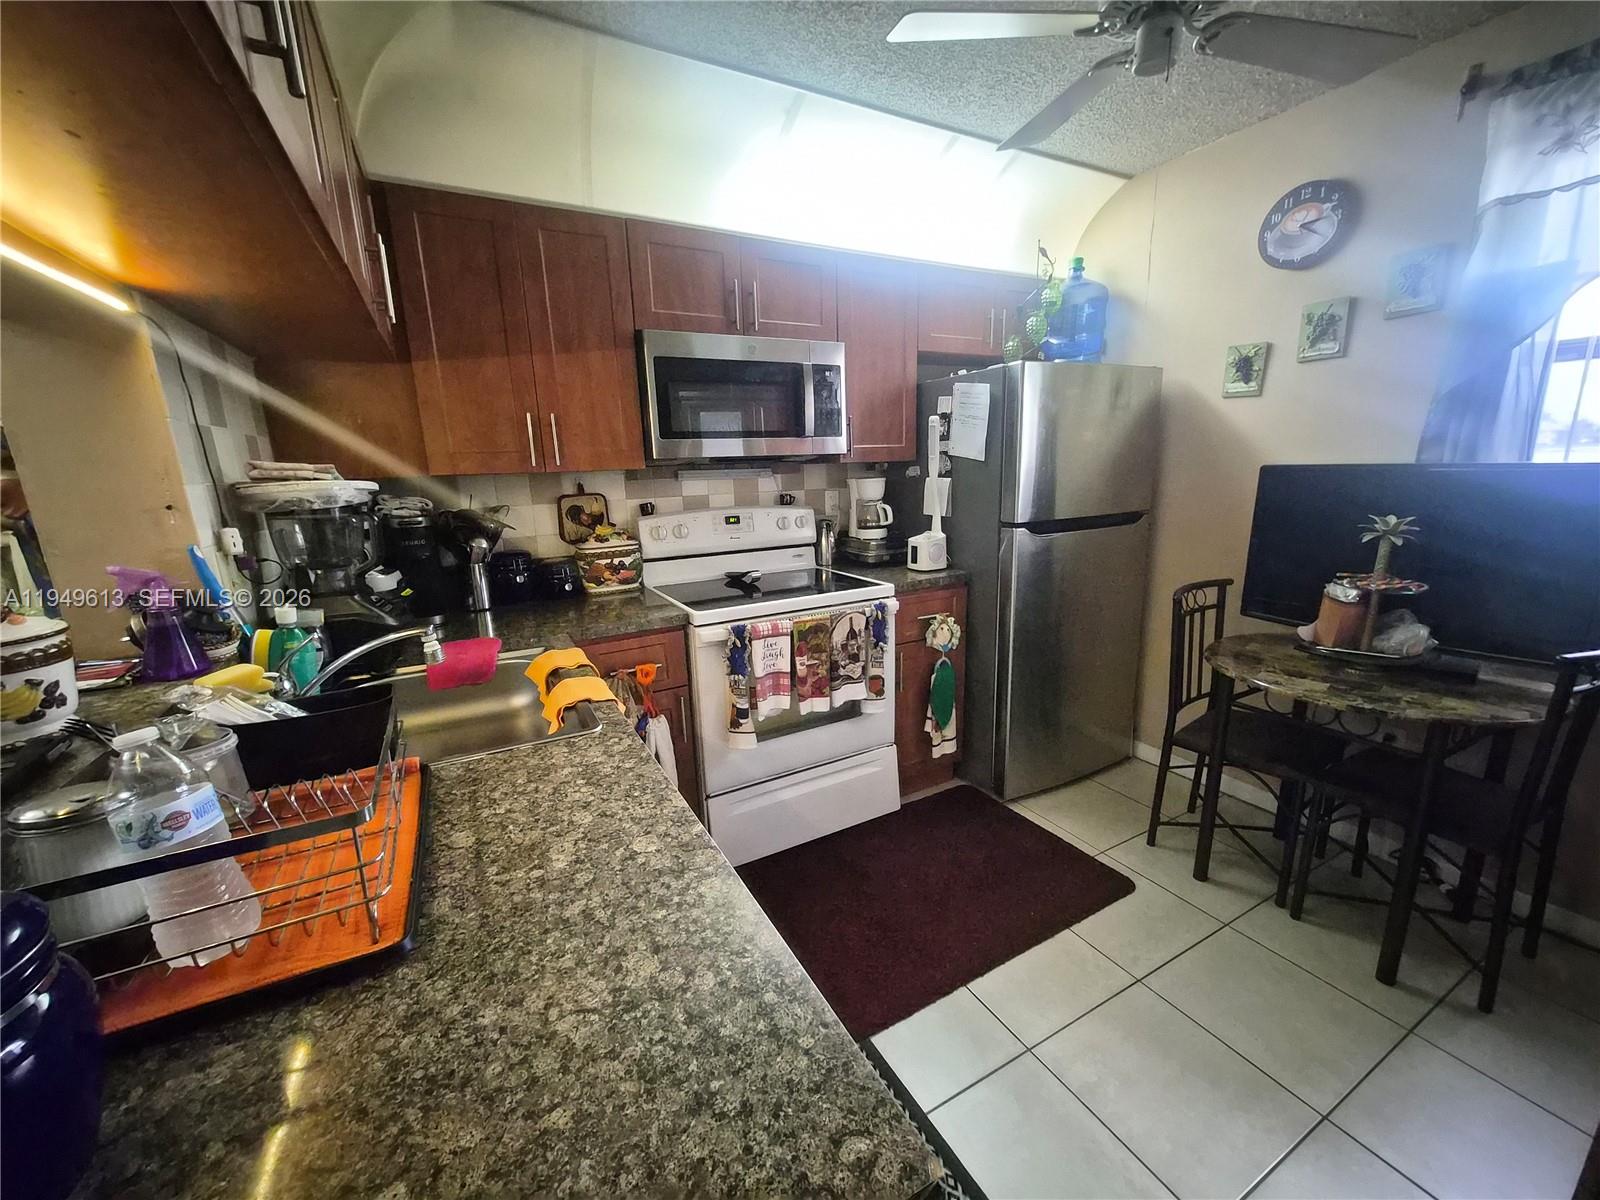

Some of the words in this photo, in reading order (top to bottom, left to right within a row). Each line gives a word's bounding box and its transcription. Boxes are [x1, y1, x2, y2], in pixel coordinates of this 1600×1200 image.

[1301, 187, 1312, 200] 12
[1320, 187, 1325, 198] 1
[1284, 198, 1293, 209] 11
[1271, 213, 1281, 224] 10
